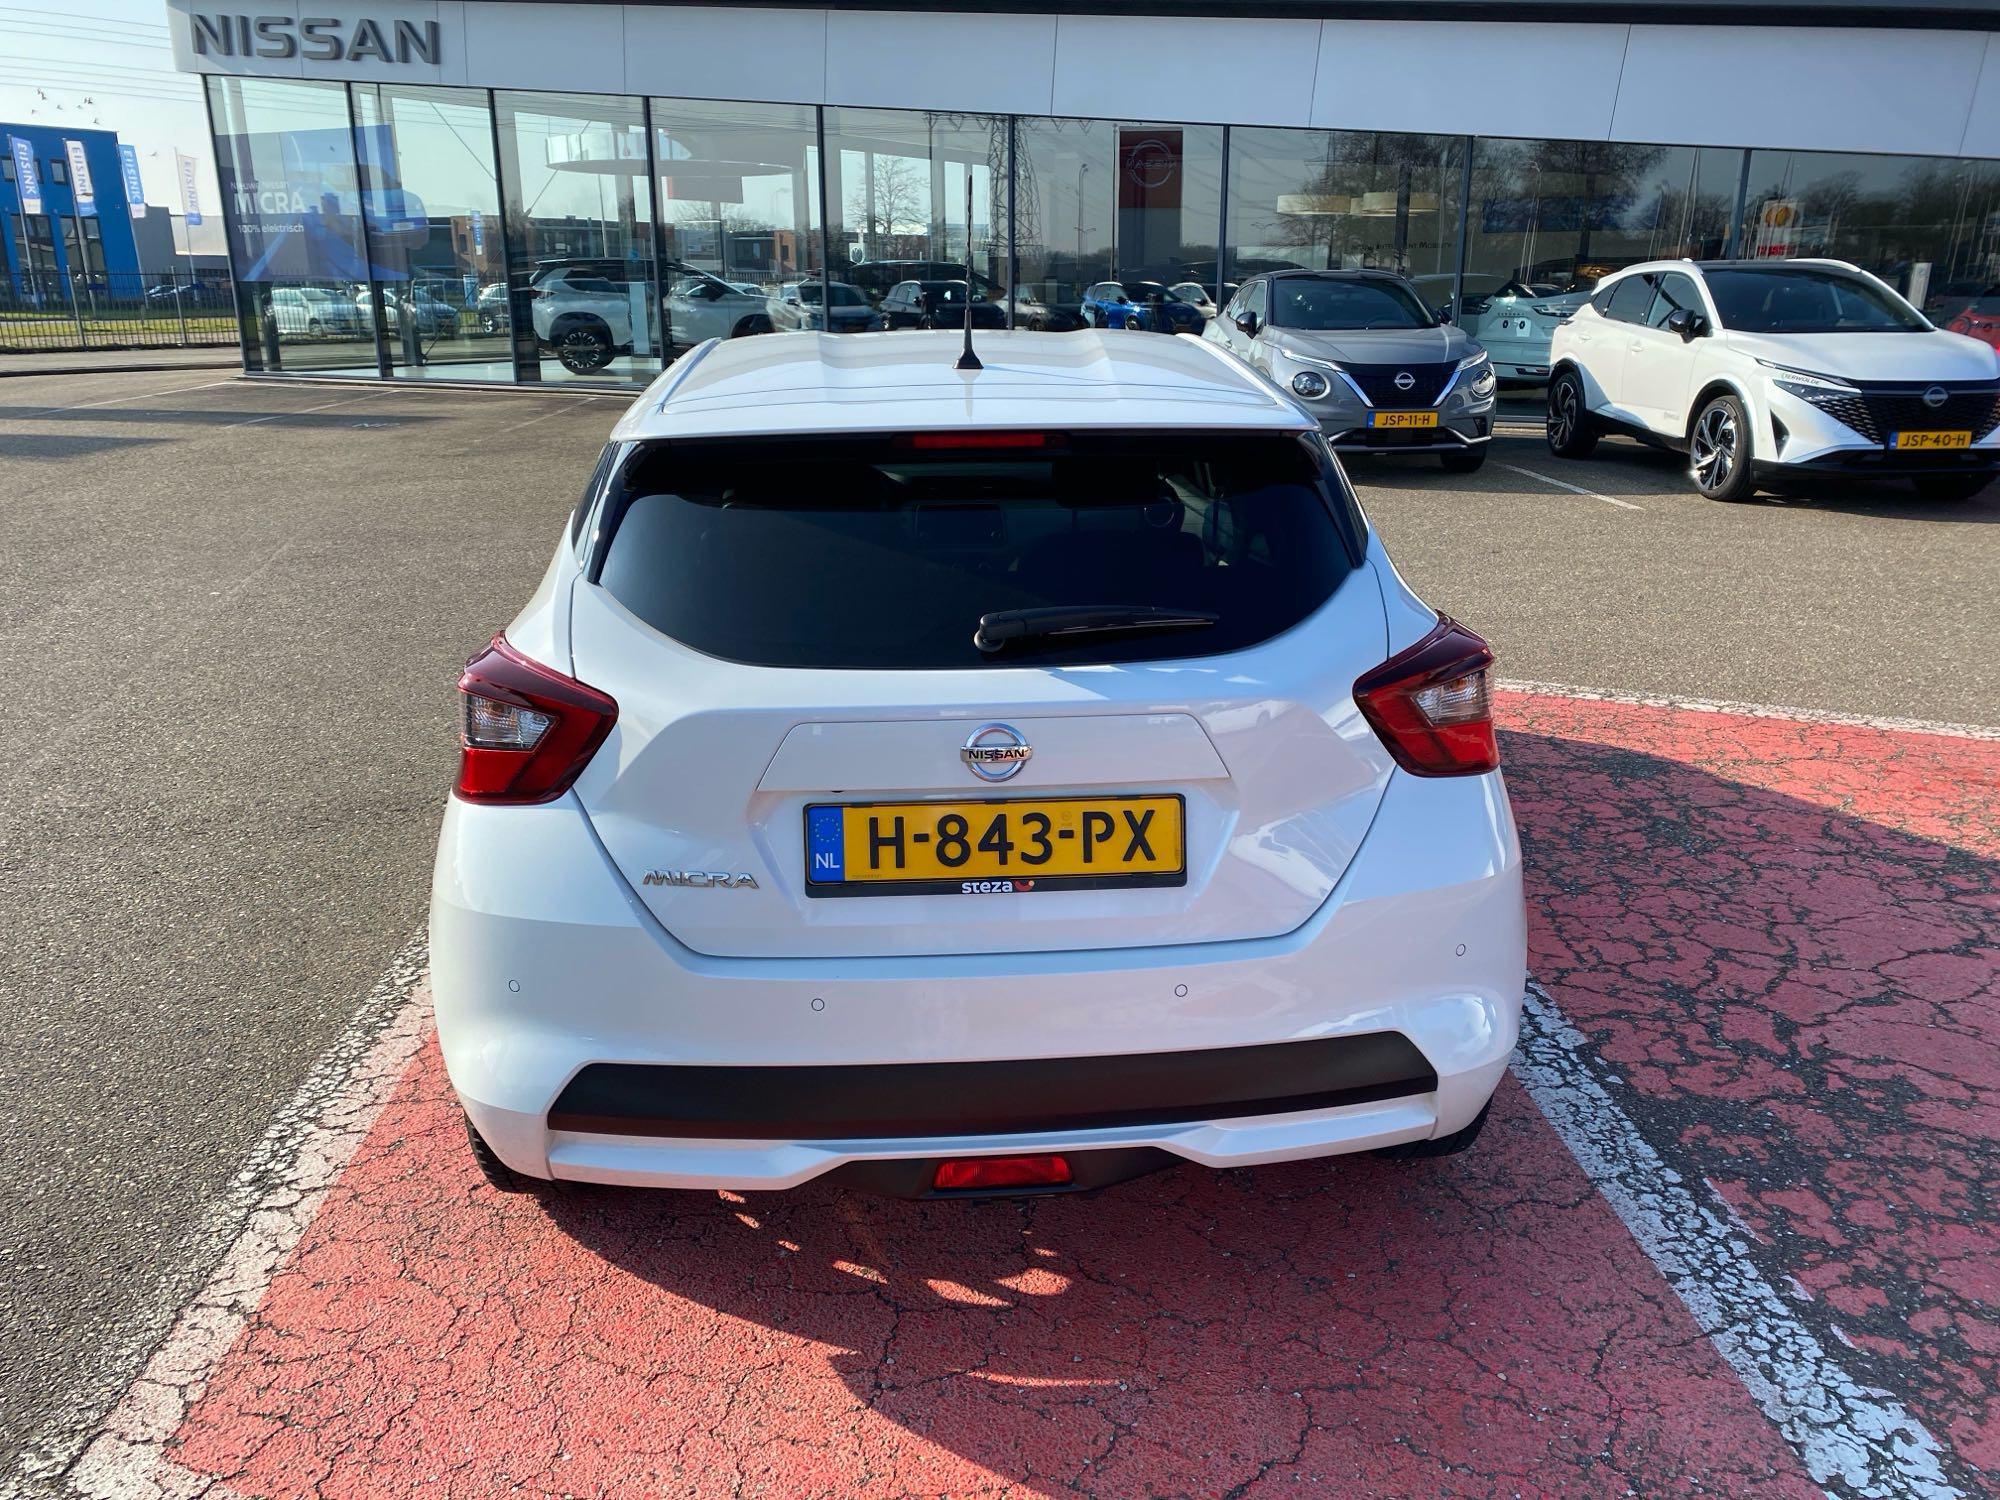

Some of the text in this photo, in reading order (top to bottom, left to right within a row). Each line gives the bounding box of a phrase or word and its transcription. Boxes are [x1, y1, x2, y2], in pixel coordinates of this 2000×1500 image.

[190, 14, 441, 64] NISSAN
[234, 191, 306, 214] MICRA
[262, 223, 304, 233] elektrisch
[1383, 415, 1430, 426] JSP-11-H
[1902, 434, 1966, 447] JSP-40-H
[968, 749, 1024, 760] NISSAN
[868, 809, 1156, 869] H-843-PX
[815, 853, 840, 869] NL
[643, 870, 760, 889] MICRA
[961, 880, 1013, 894] steza
